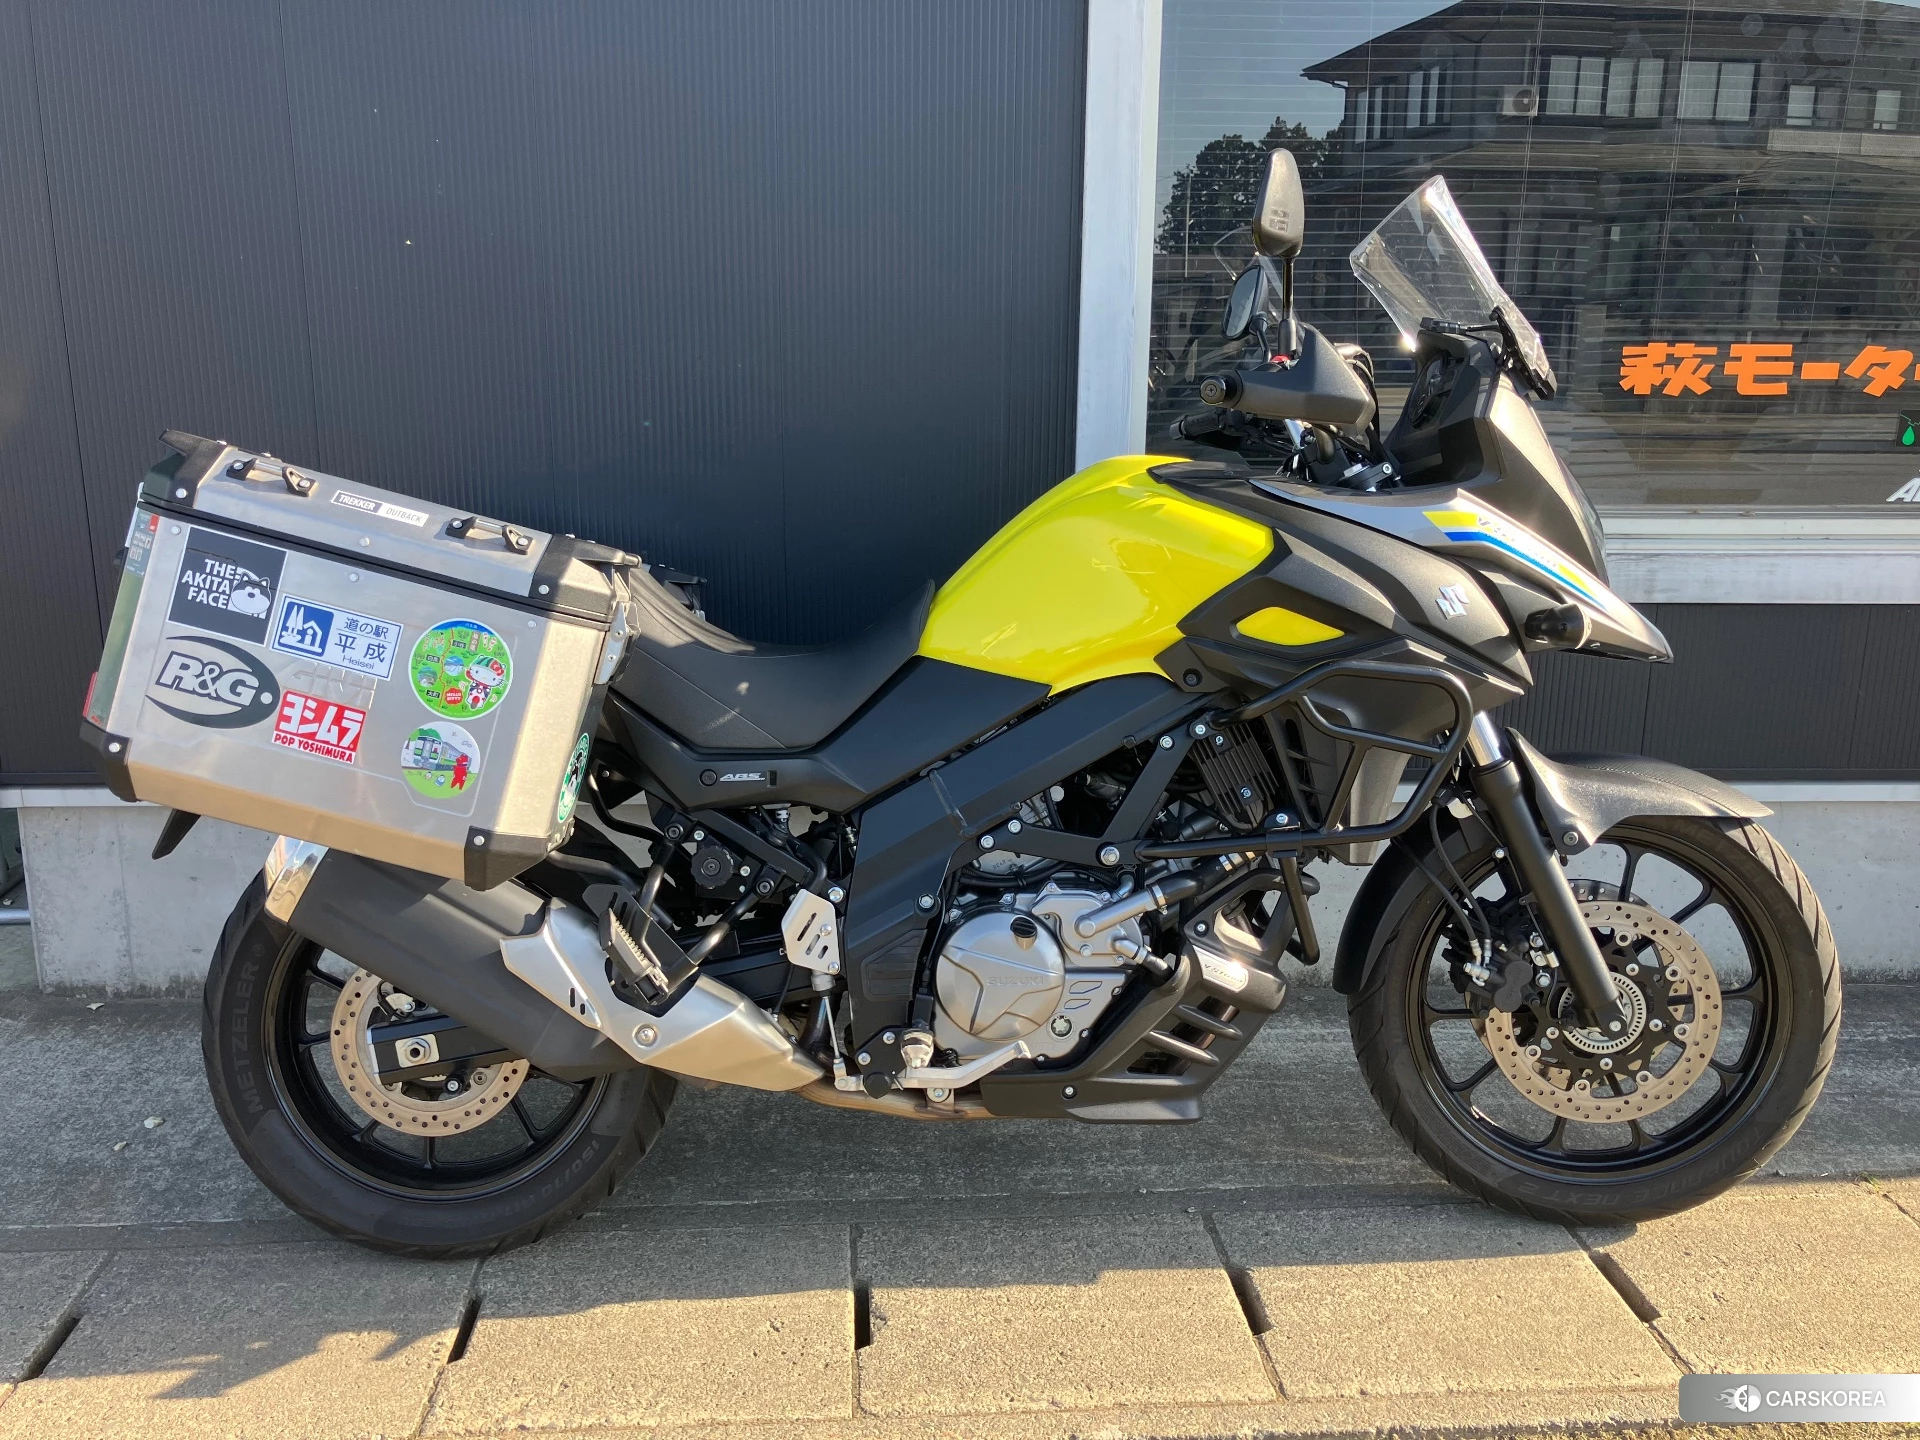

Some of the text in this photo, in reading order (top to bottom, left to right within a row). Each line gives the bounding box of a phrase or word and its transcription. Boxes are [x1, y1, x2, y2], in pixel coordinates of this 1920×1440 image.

[1619, 342, 1920, 397] 萩モータ
[1886, 477, 1920, 502] A
[338, 494, 422, 523] TREKKER OUTBACK
[181, 569, 231, 595] AKITA
[204, 558, 236, 580] THE
[187, 586, 229, 609] FACE
[344, 616, 389, 640] 道の駅
[334, 634, 388, 663] 平成
[342, 654, 375, 671] Heisei
[155, 650, 260, 707] R&G
[279, 692, 364, 748] ヨシムラ
[273, 732, 354, 764] POP YOSHIMURA
[720, 772, 764, 782] ABS
[986, 976, 1045, 987] SUZUKI
[231, 961, 264, 1115] METZELER
